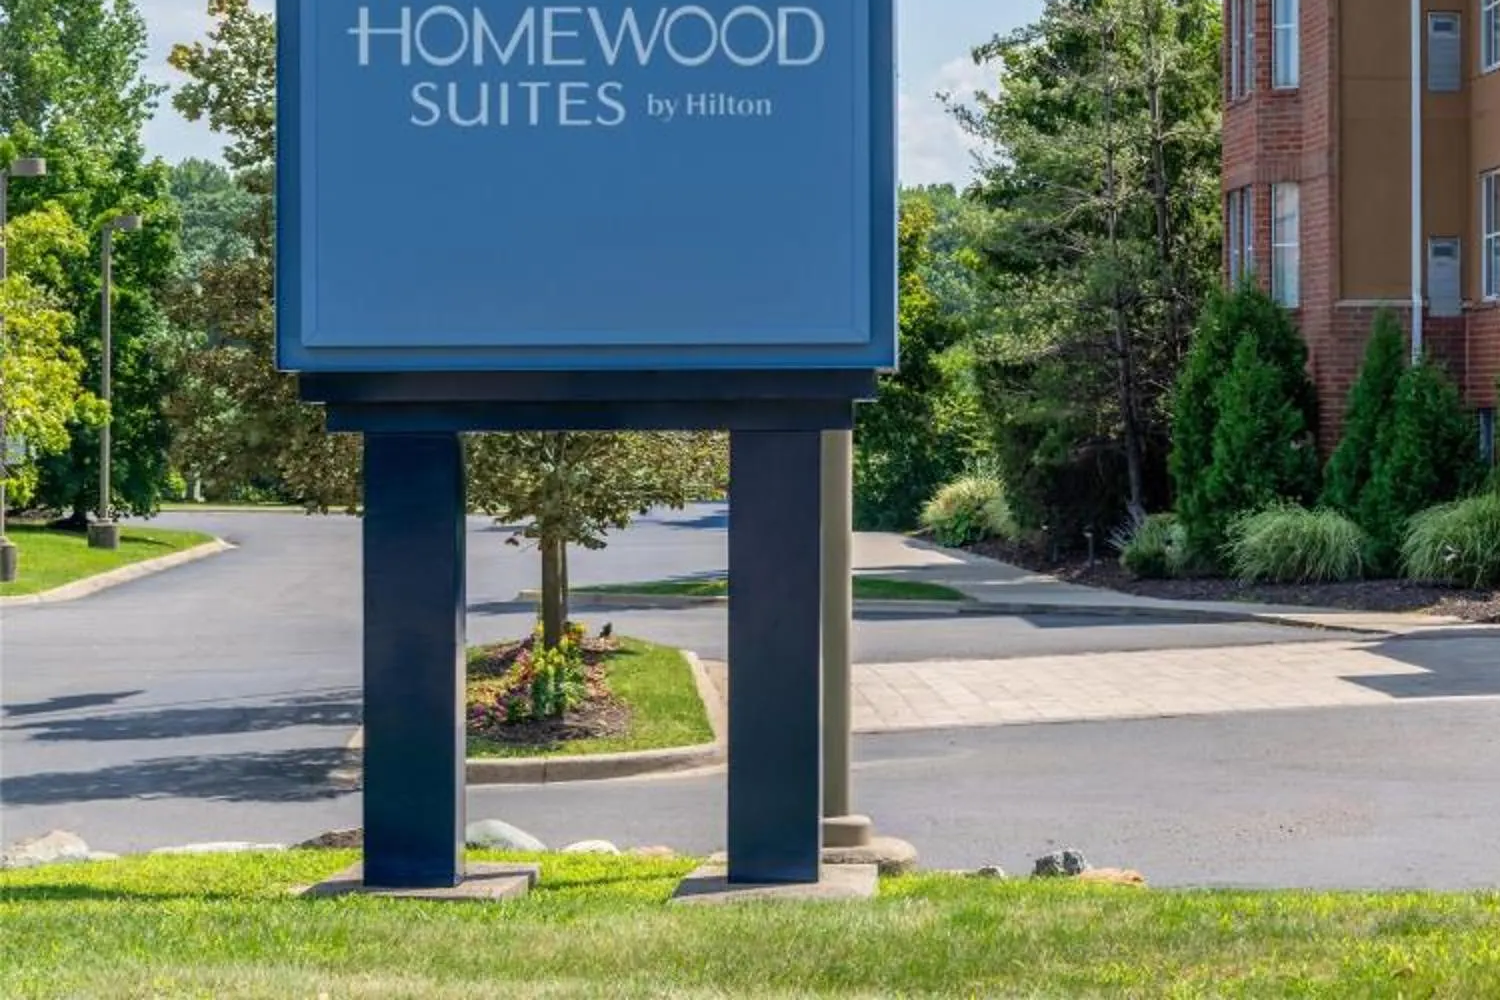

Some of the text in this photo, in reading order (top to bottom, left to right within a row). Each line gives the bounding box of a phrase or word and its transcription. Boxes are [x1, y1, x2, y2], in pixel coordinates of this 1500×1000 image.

[347, 5, 825, 66] HOMEWOOD
[410, 82, 773, 126] SUITES by Hilton
